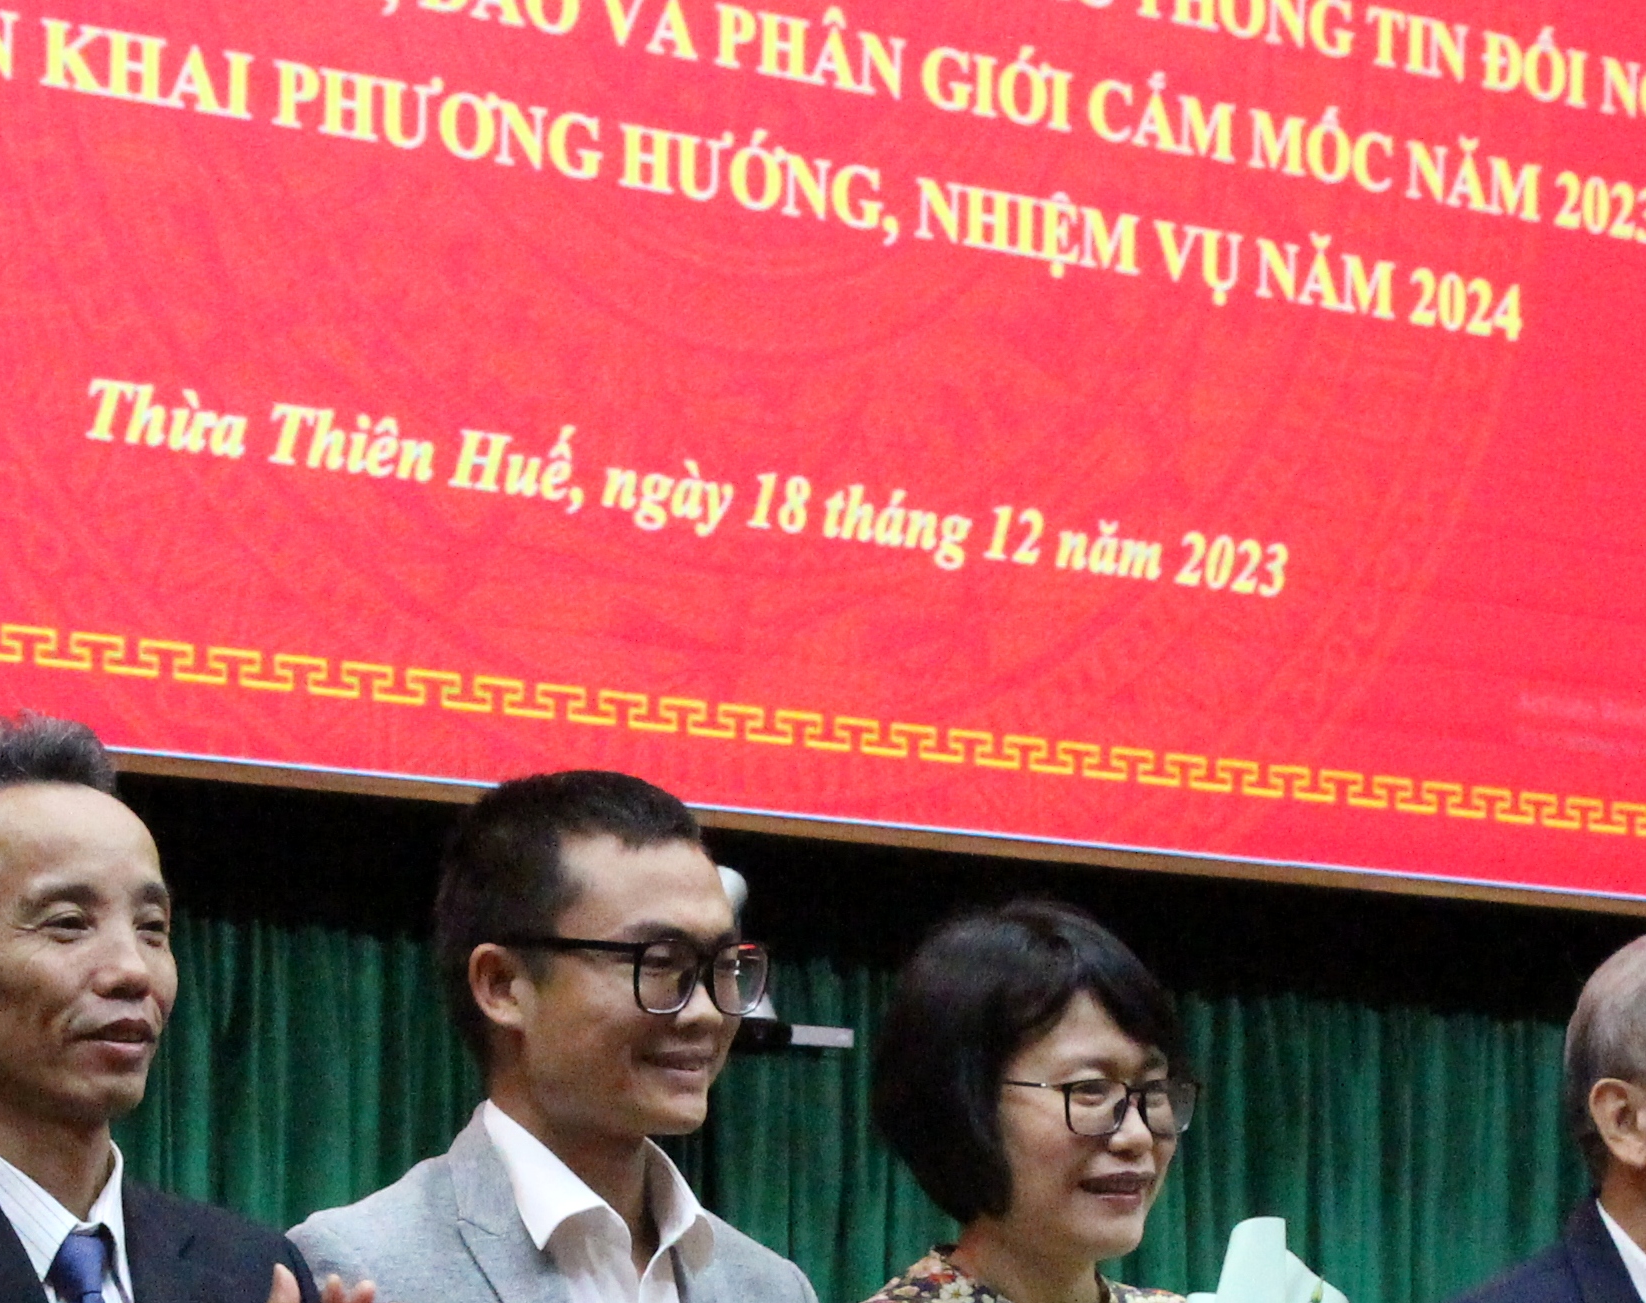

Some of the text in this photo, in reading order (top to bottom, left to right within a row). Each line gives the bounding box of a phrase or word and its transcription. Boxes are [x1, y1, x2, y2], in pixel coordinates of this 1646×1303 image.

[715, 3, 906, 99] PHÂN
[921, 45, 1072, 132] GIỚI
[1088, 72, 1235, 163] CẮM
[1248, 106, 1393, 192] MỐC
[1406, 136, 1541, 222] NĂM
[1366, 6, 1468, 81] TIN
[1482, 26, 1586, 108] ĐỐI
[40, 18, 254, 120] KHAI
[272, 60, 603, 180] PHƯƠNG
[619, 123, 899, 245] HƯỚNG,
[915, 177, 1140, 278] NHIỆM
[1154, 220, 1243, 306] VỤ
[1256, 232, 1395, 320] NĂM
[1409, 268, 1522, 341] 2024
[86, 378, 1288, 597] Thừa Thiên Huế, ngày 18 tháng 12 năm 2023
